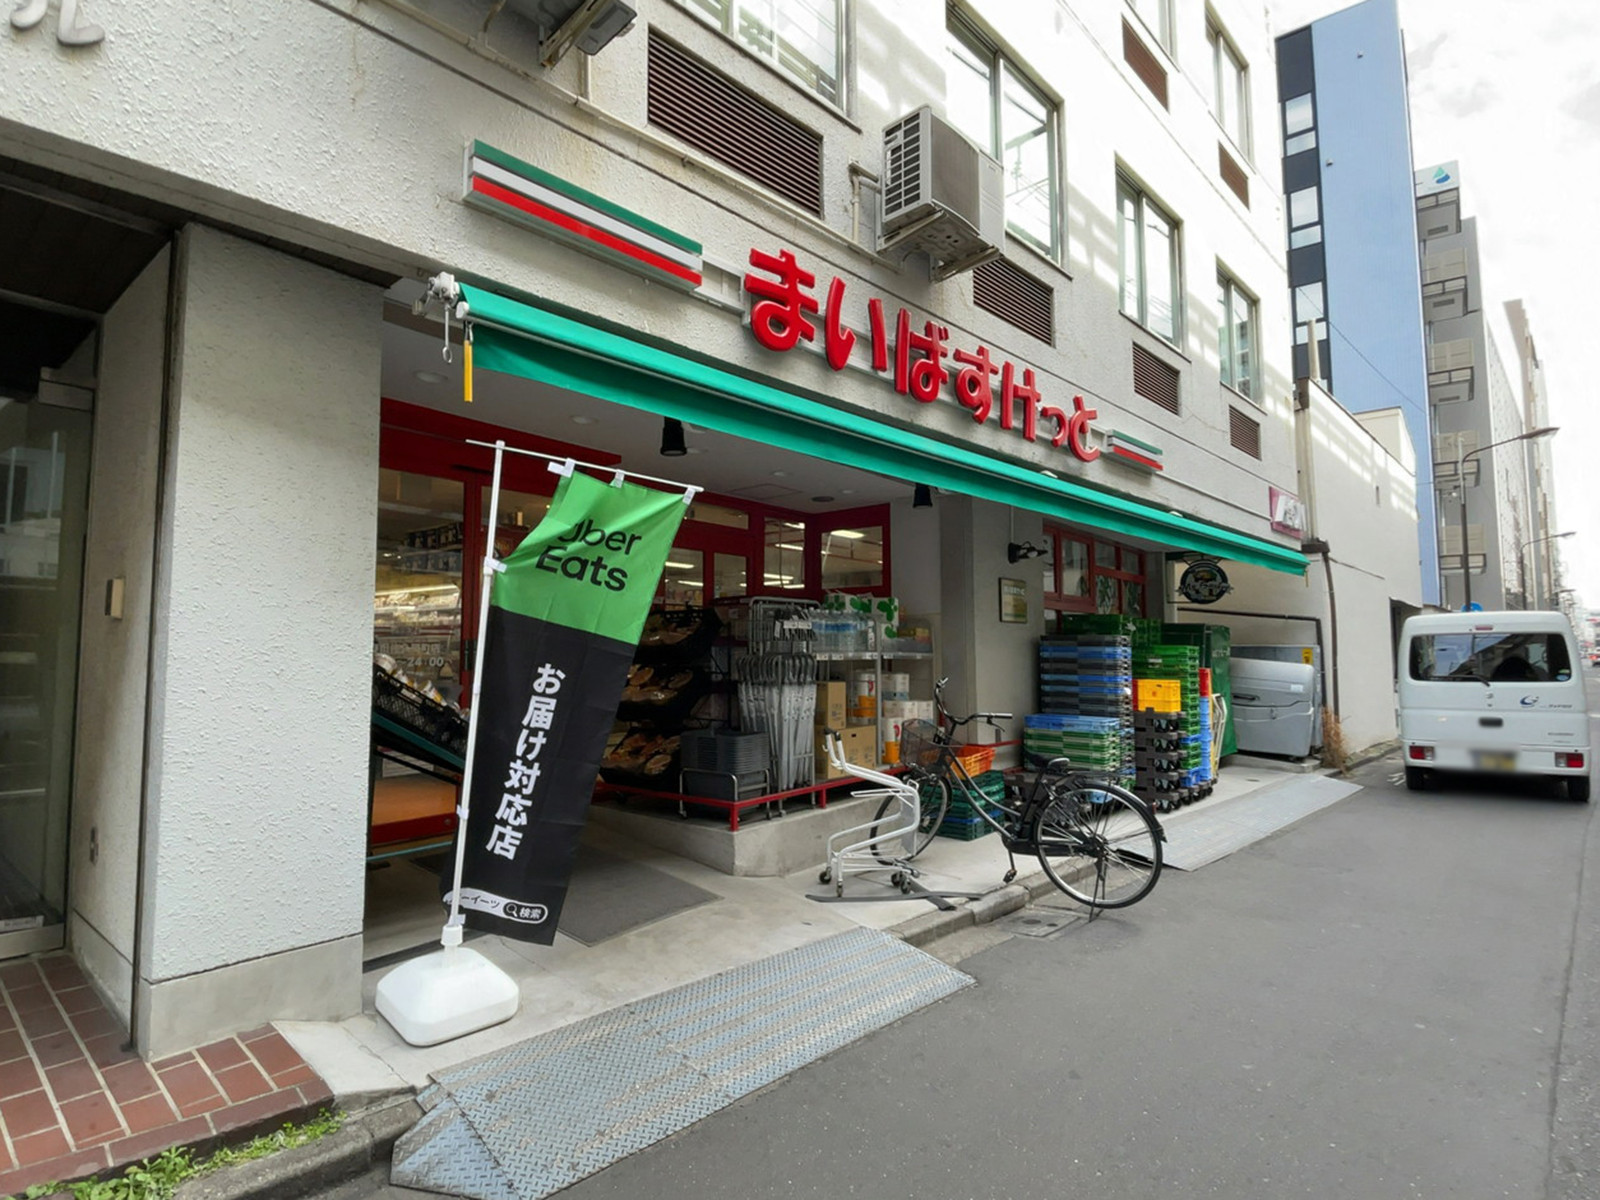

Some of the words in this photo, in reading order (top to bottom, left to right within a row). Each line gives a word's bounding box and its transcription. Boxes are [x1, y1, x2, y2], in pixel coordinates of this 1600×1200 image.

[744, 248, 1099, 462] まいばすけっと
[535, 545, 628, 591] Eats
[485, 663, 565, 860] お届け対応店
[519, 906, 542, 919] 検索
